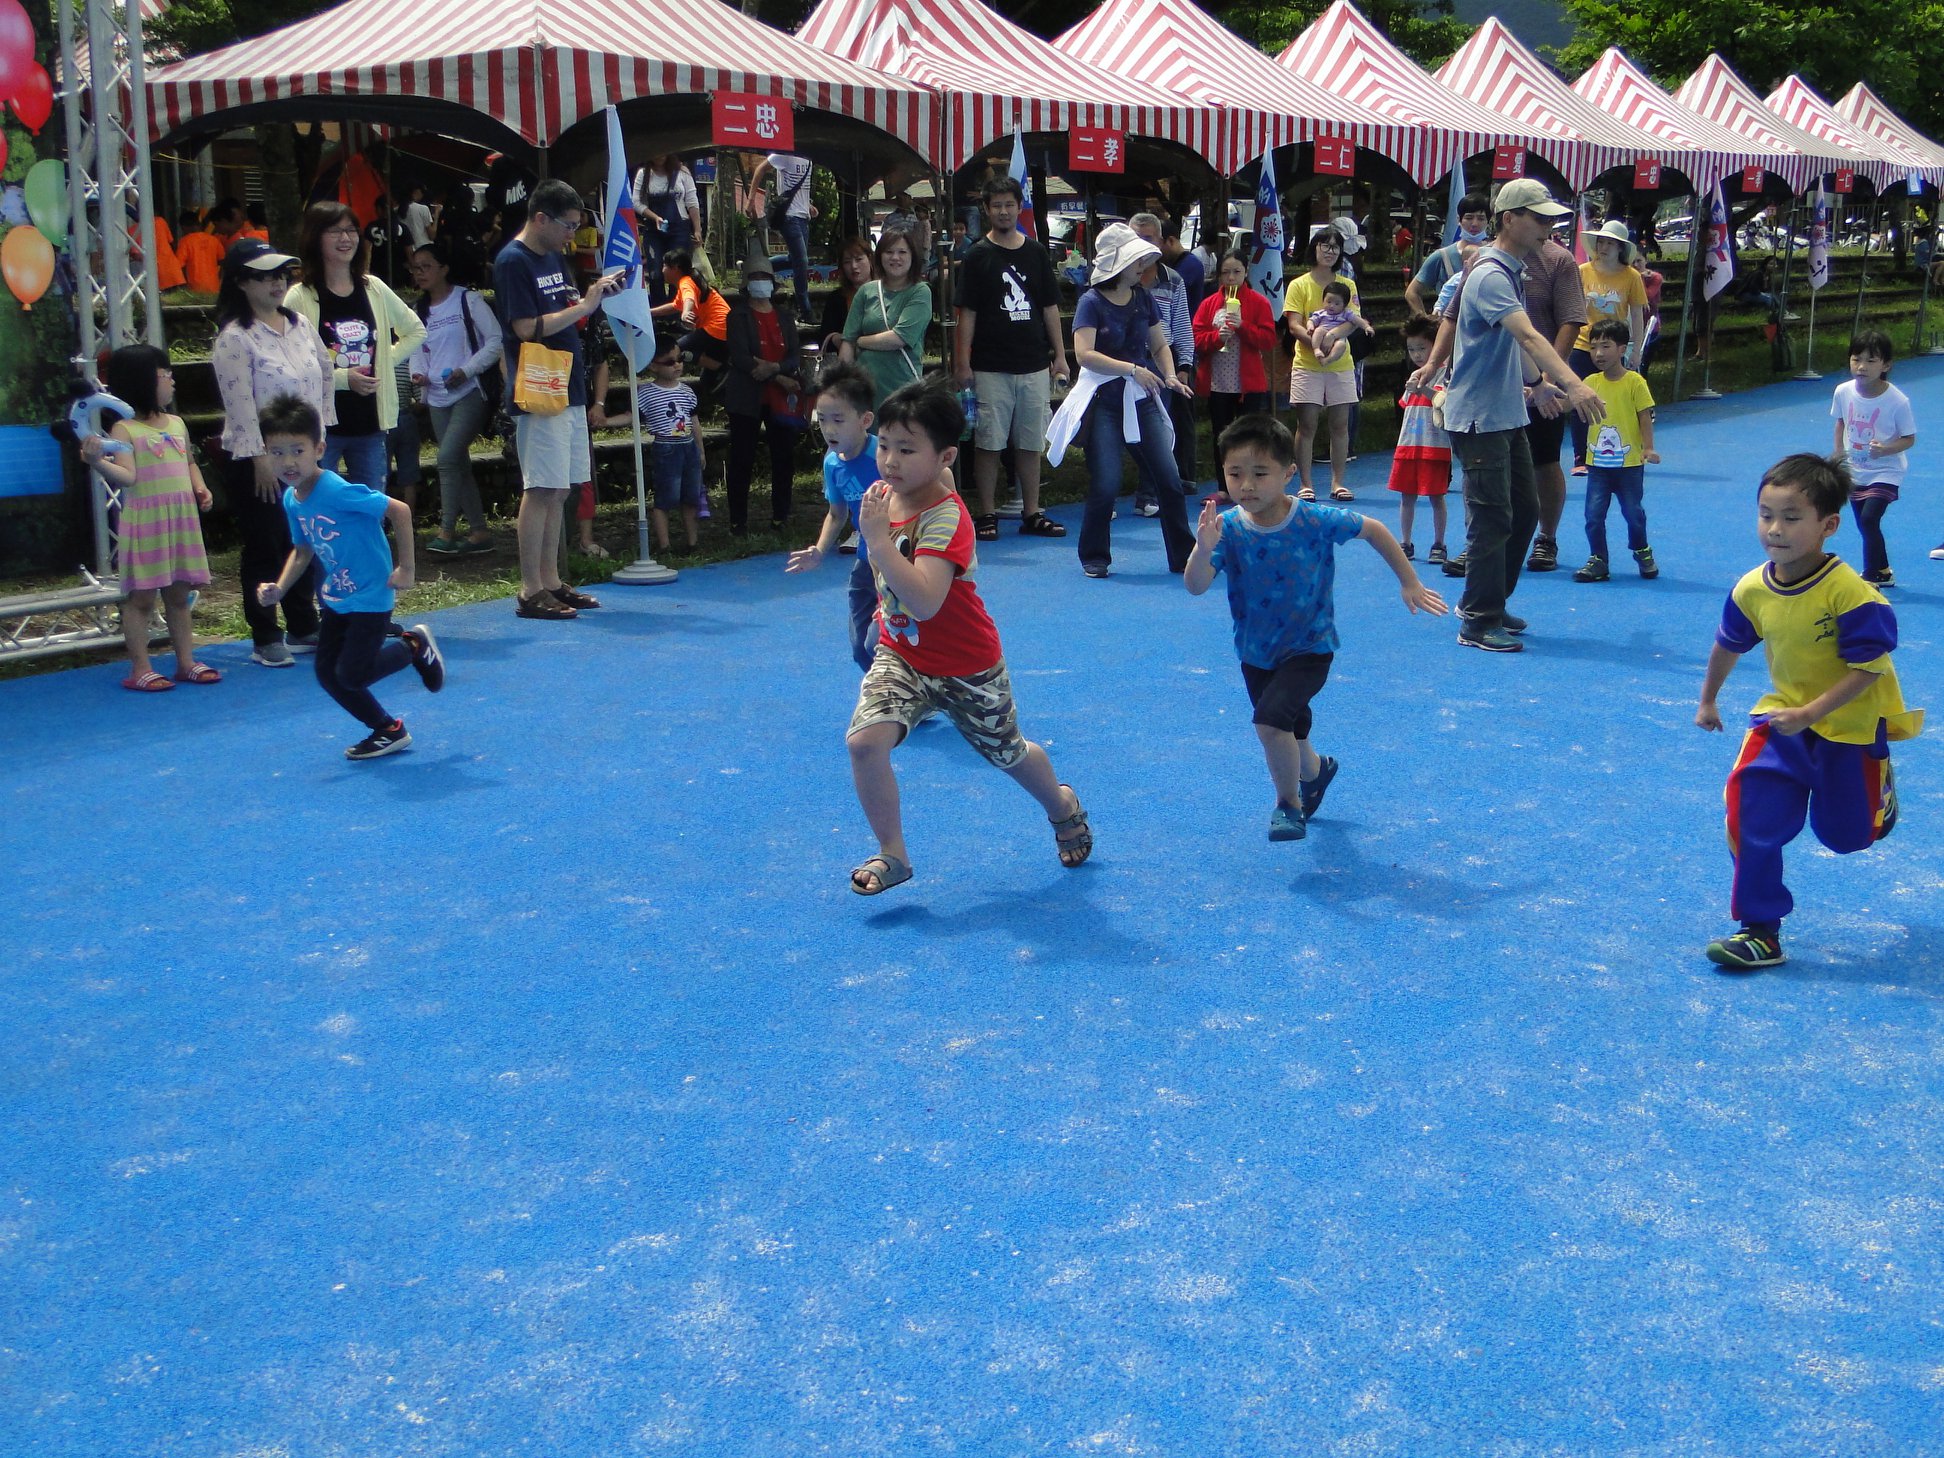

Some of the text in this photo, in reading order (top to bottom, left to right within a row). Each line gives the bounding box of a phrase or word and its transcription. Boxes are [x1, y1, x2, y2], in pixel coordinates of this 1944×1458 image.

[724, 104, 779, 138] 二忠
[1077, 137, 1118, 167] 二孝
[1320, 144, 1350, 169] 二仁
[1497, 152, 1523, 174] 二愛
[844, 491, 864, 501] adid
